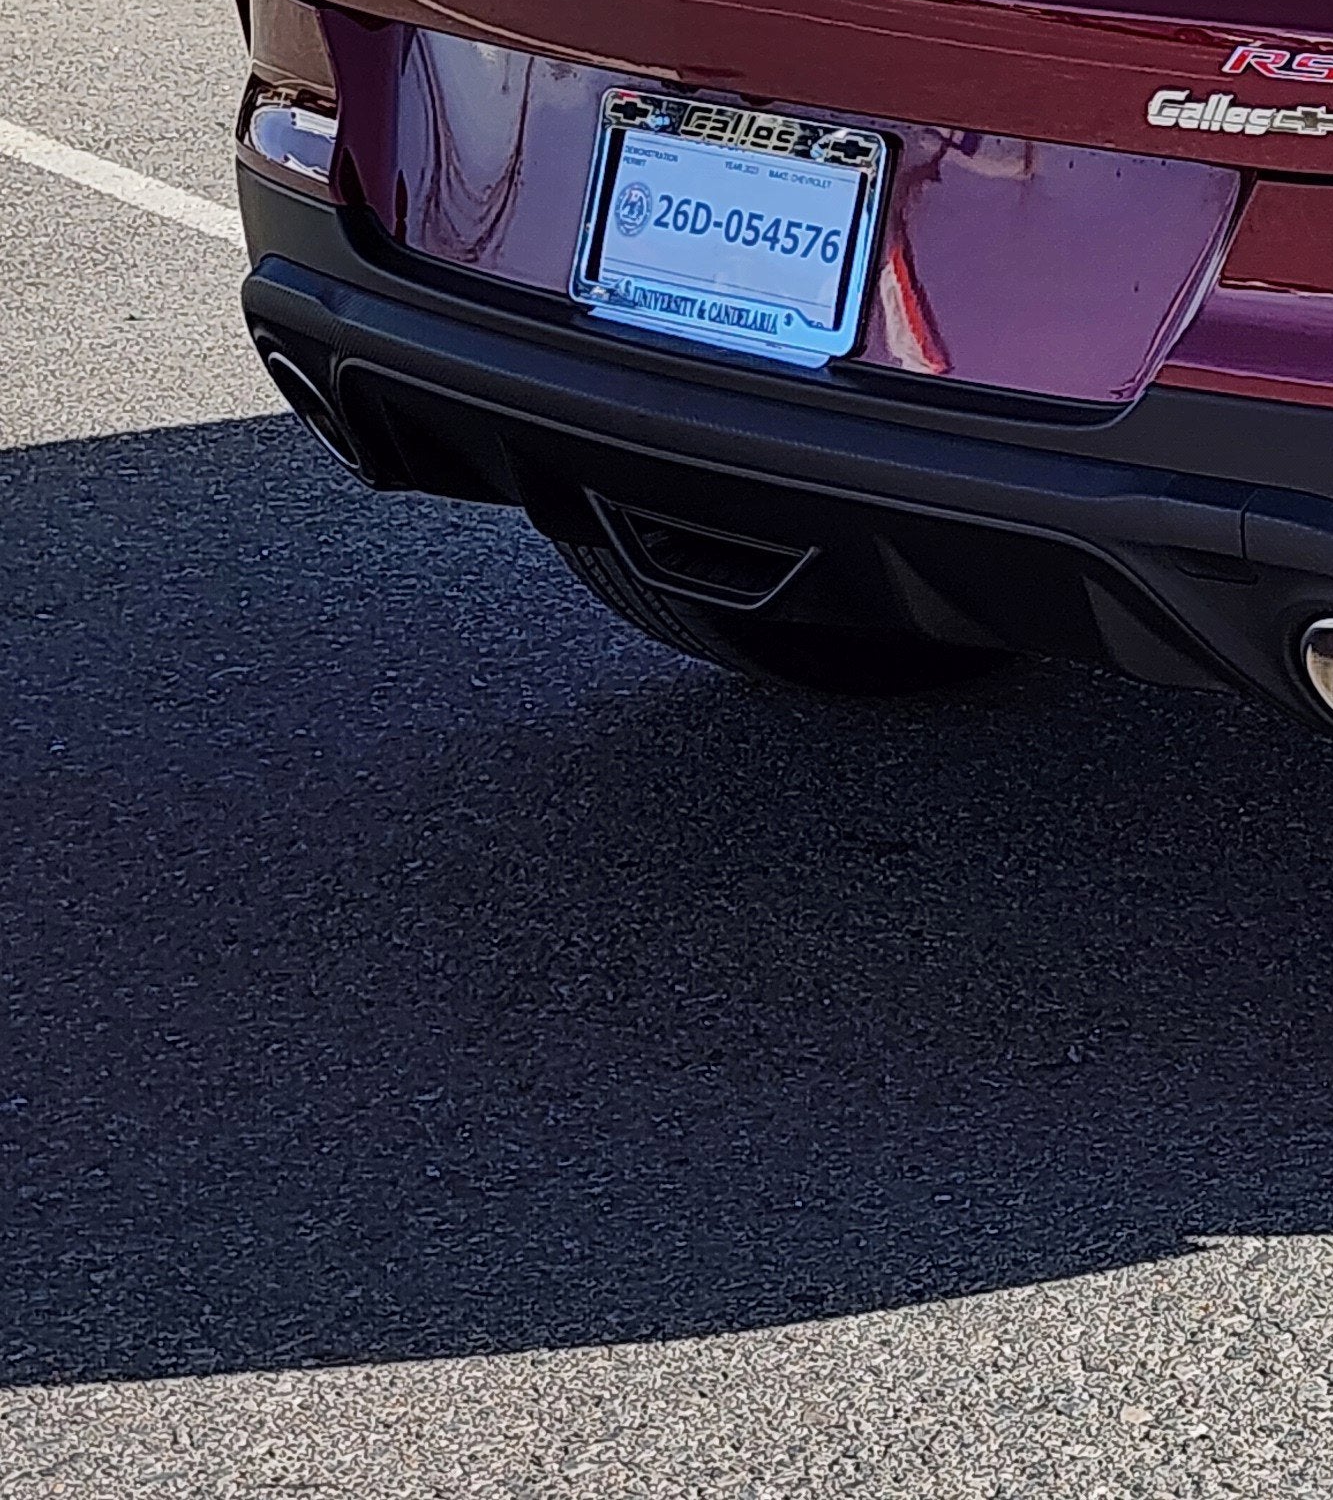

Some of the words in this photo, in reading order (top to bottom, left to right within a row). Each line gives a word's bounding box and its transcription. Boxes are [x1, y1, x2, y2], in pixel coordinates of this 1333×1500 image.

[680, 102, 797, 152] Galles
[1146, 88, 1277, 136] Galles
[653, 194, 842, 264] 26D-054576
[631, 285, 701, 322] UNIVERSITY
[707, 301, 780, 336] CANDELARIA
